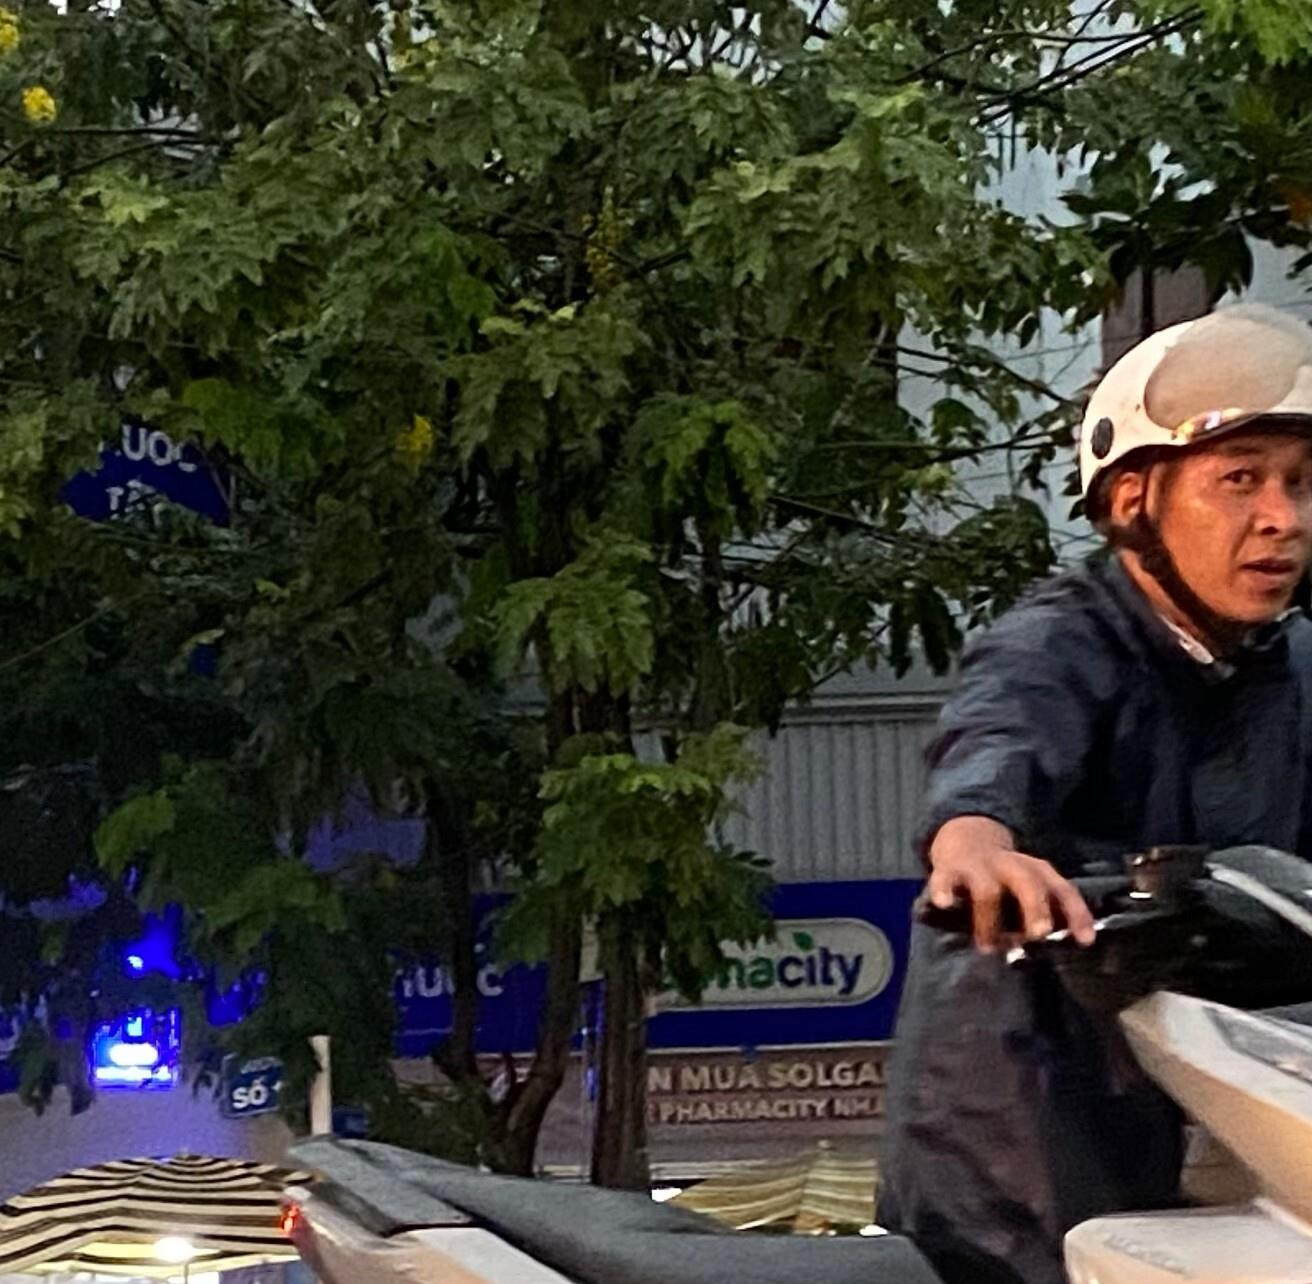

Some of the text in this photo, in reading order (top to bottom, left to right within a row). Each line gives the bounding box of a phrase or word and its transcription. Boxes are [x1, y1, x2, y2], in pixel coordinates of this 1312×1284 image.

[681, 1063, 763, 1091] MUA
[767, 1061, 885, 1090] SOLGA
[659, 1098, 828, 1122] PHARMACITY
